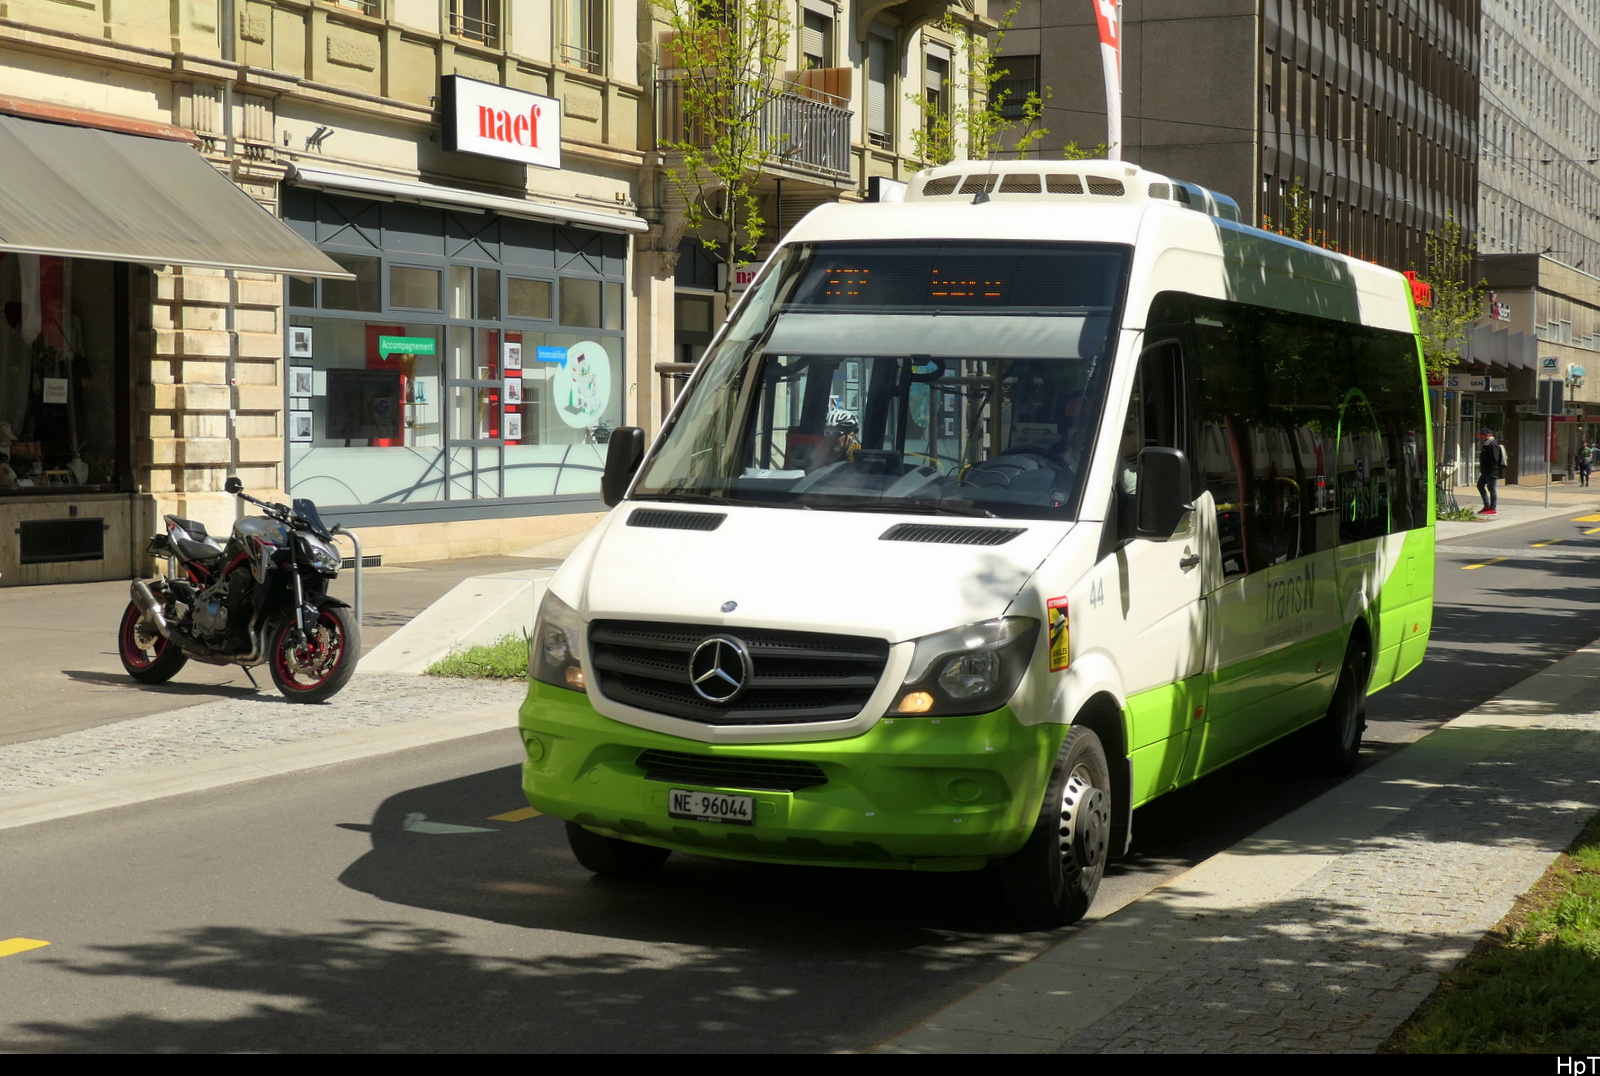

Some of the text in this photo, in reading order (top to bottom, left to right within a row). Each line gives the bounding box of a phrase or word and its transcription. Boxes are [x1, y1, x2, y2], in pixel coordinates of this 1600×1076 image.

[476, 103, 542, 149] naef
[381, 339, 434, 353] Accompagnement
[538, 349, 567, 360] Immobilier
[1090, 577, 1104, 609] 44
[674, 794, 748, 817] NE 96044
